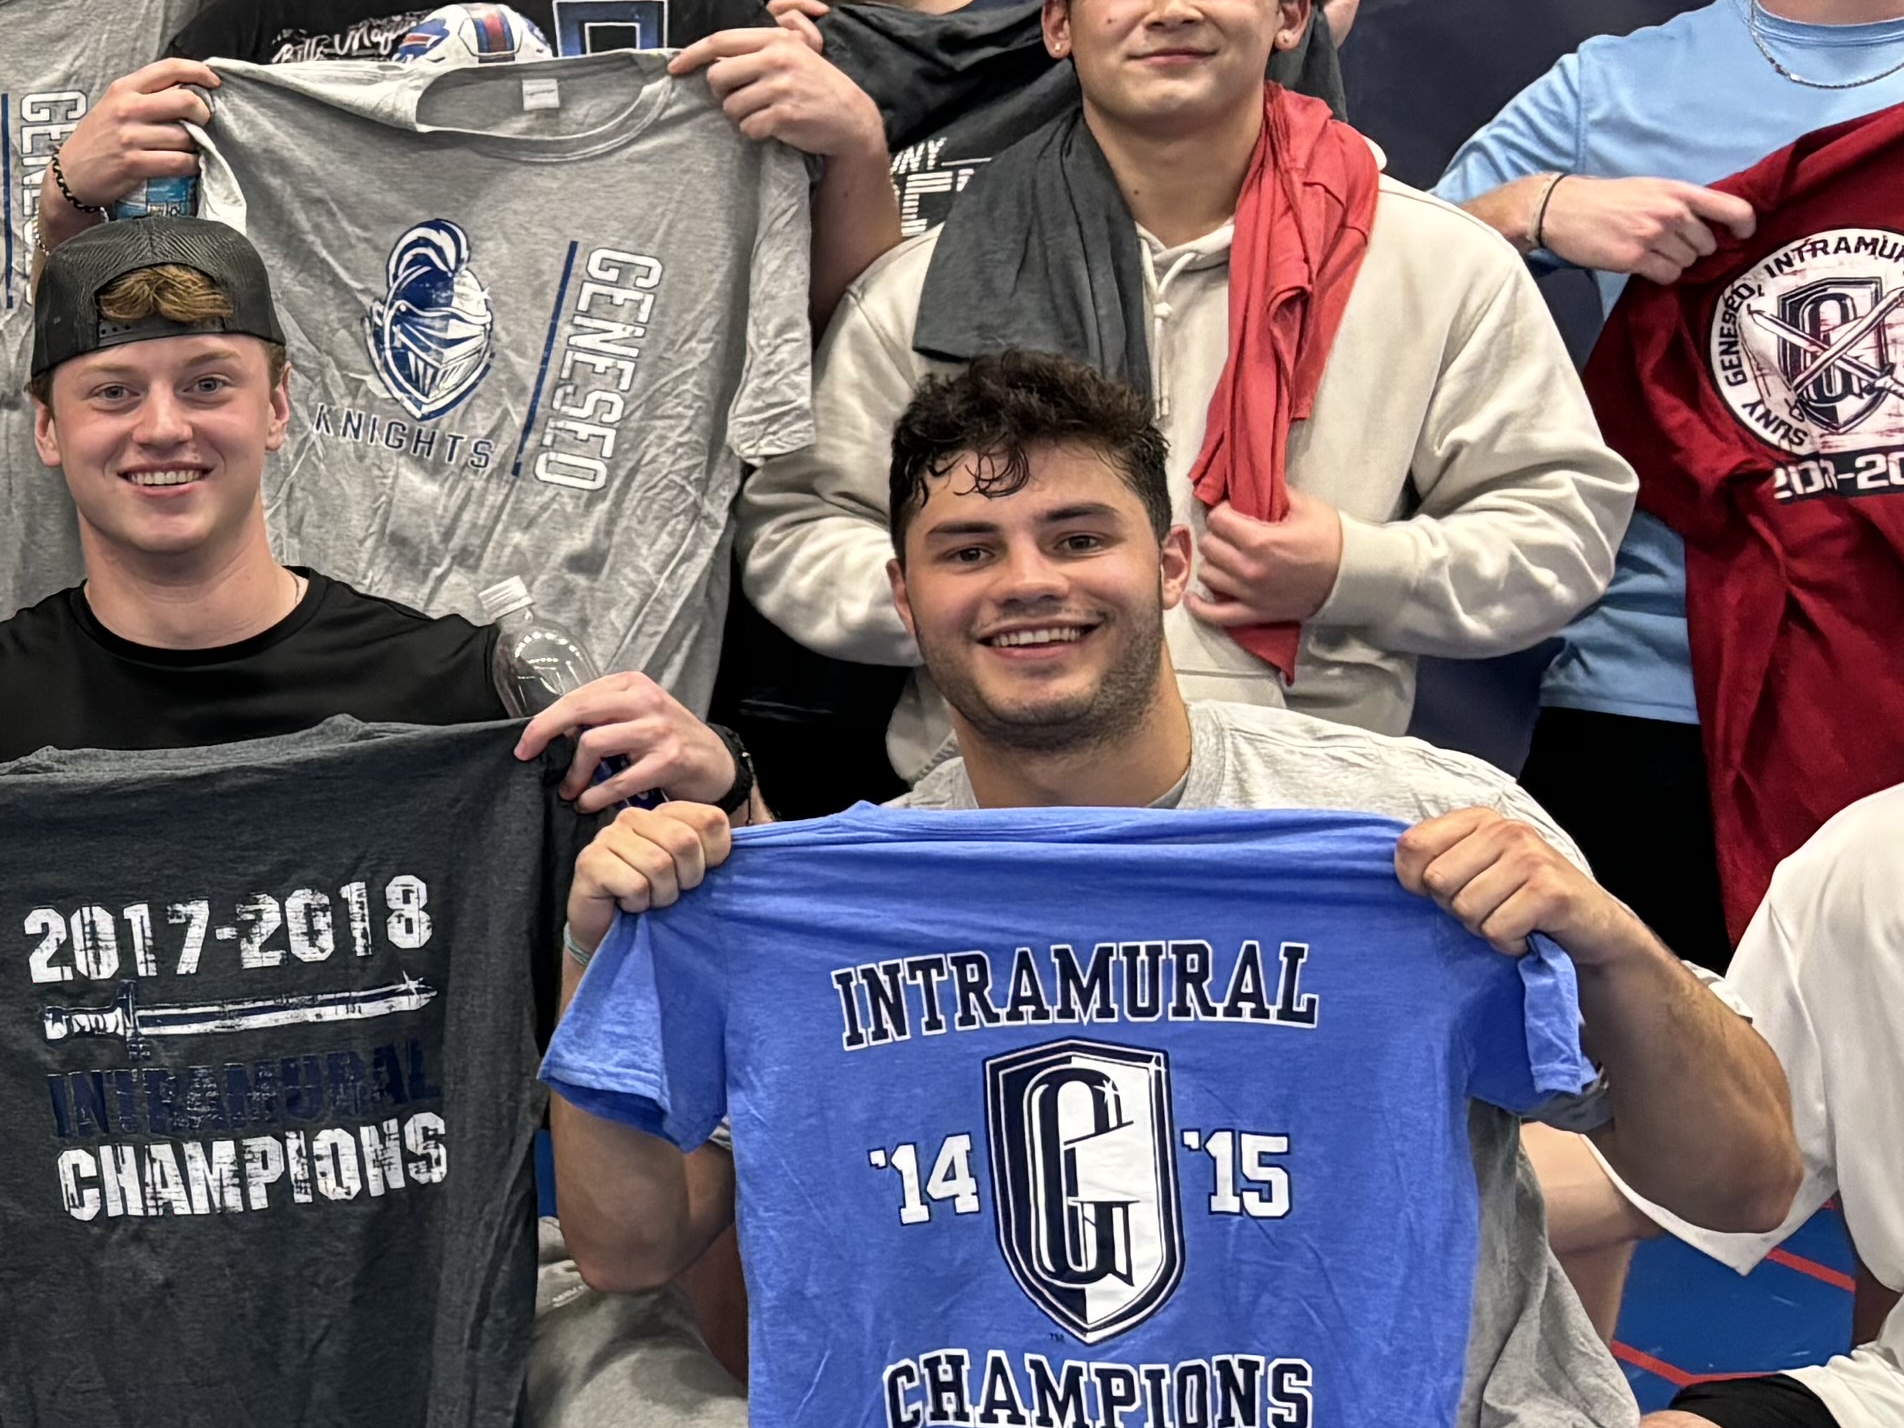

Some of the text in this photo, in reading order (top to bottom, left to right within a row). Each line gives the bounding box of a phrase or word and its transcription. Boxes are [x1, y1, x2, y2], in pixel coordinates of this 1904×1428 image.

[534, 247, 664, 491] GENESEO
[312, 402, 495, 471] KNIGHTS
[1741, 400, 1809, 448] SUNY
[23, 874, 434, 985] 2017-2018
[831, 938, 1320, 1052] INTRAMURAL
[47, 1036, 442, 1139] INTRAMURAL
[57, 1111, 449, 1222] CHAMPIONS
[1181, 1128, 1293, 1220] '15
